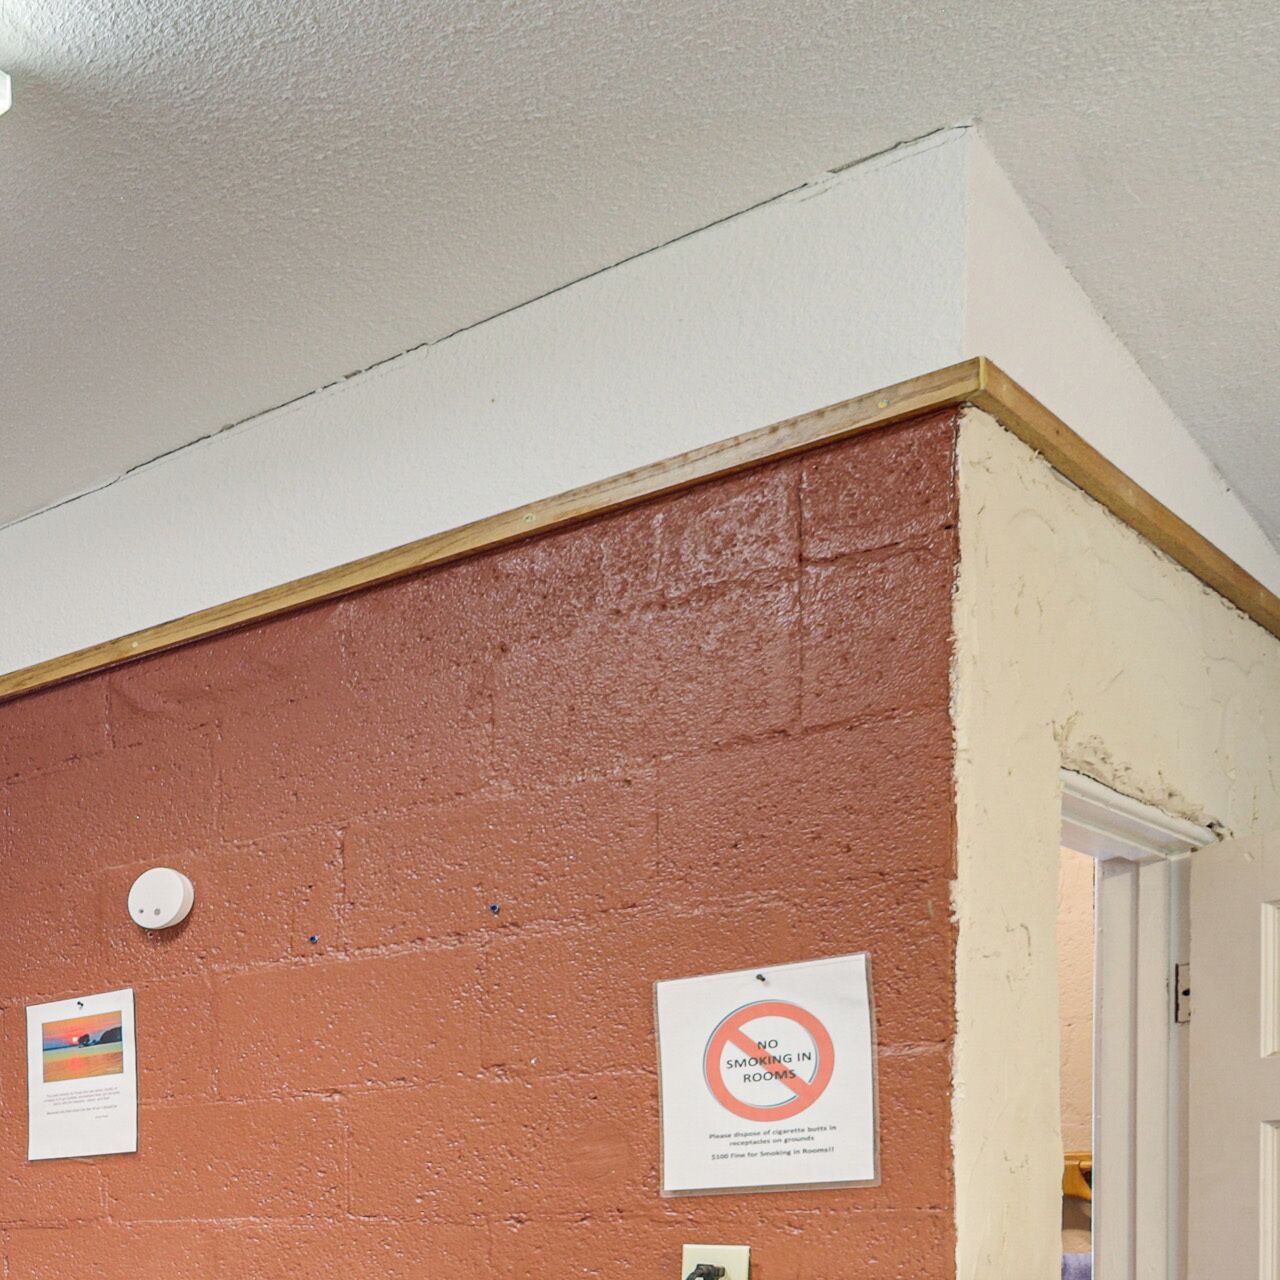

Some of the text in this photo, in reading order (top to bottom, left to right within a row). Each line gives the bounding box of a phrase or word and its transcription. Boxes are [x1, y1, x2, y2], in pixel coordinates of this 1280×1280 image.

[757, 1039, 778, 1050] NO
[726, 1052, 812, 1069] SMOKING IN
[743, 1069, 797, 1083] ROOMS
[733, 1130, 761, 1138] dispose
[772, 1127, 805, 1136] cigarette
[729, 1138, 771, 1147] receptacles
[783, 1135, 815, 1144] grounds
[711, 1153, 729, 1161] $100
[759, 1148, 792, 1157] Smoking
[802, 1146, 835, 1154] Rooms!!
